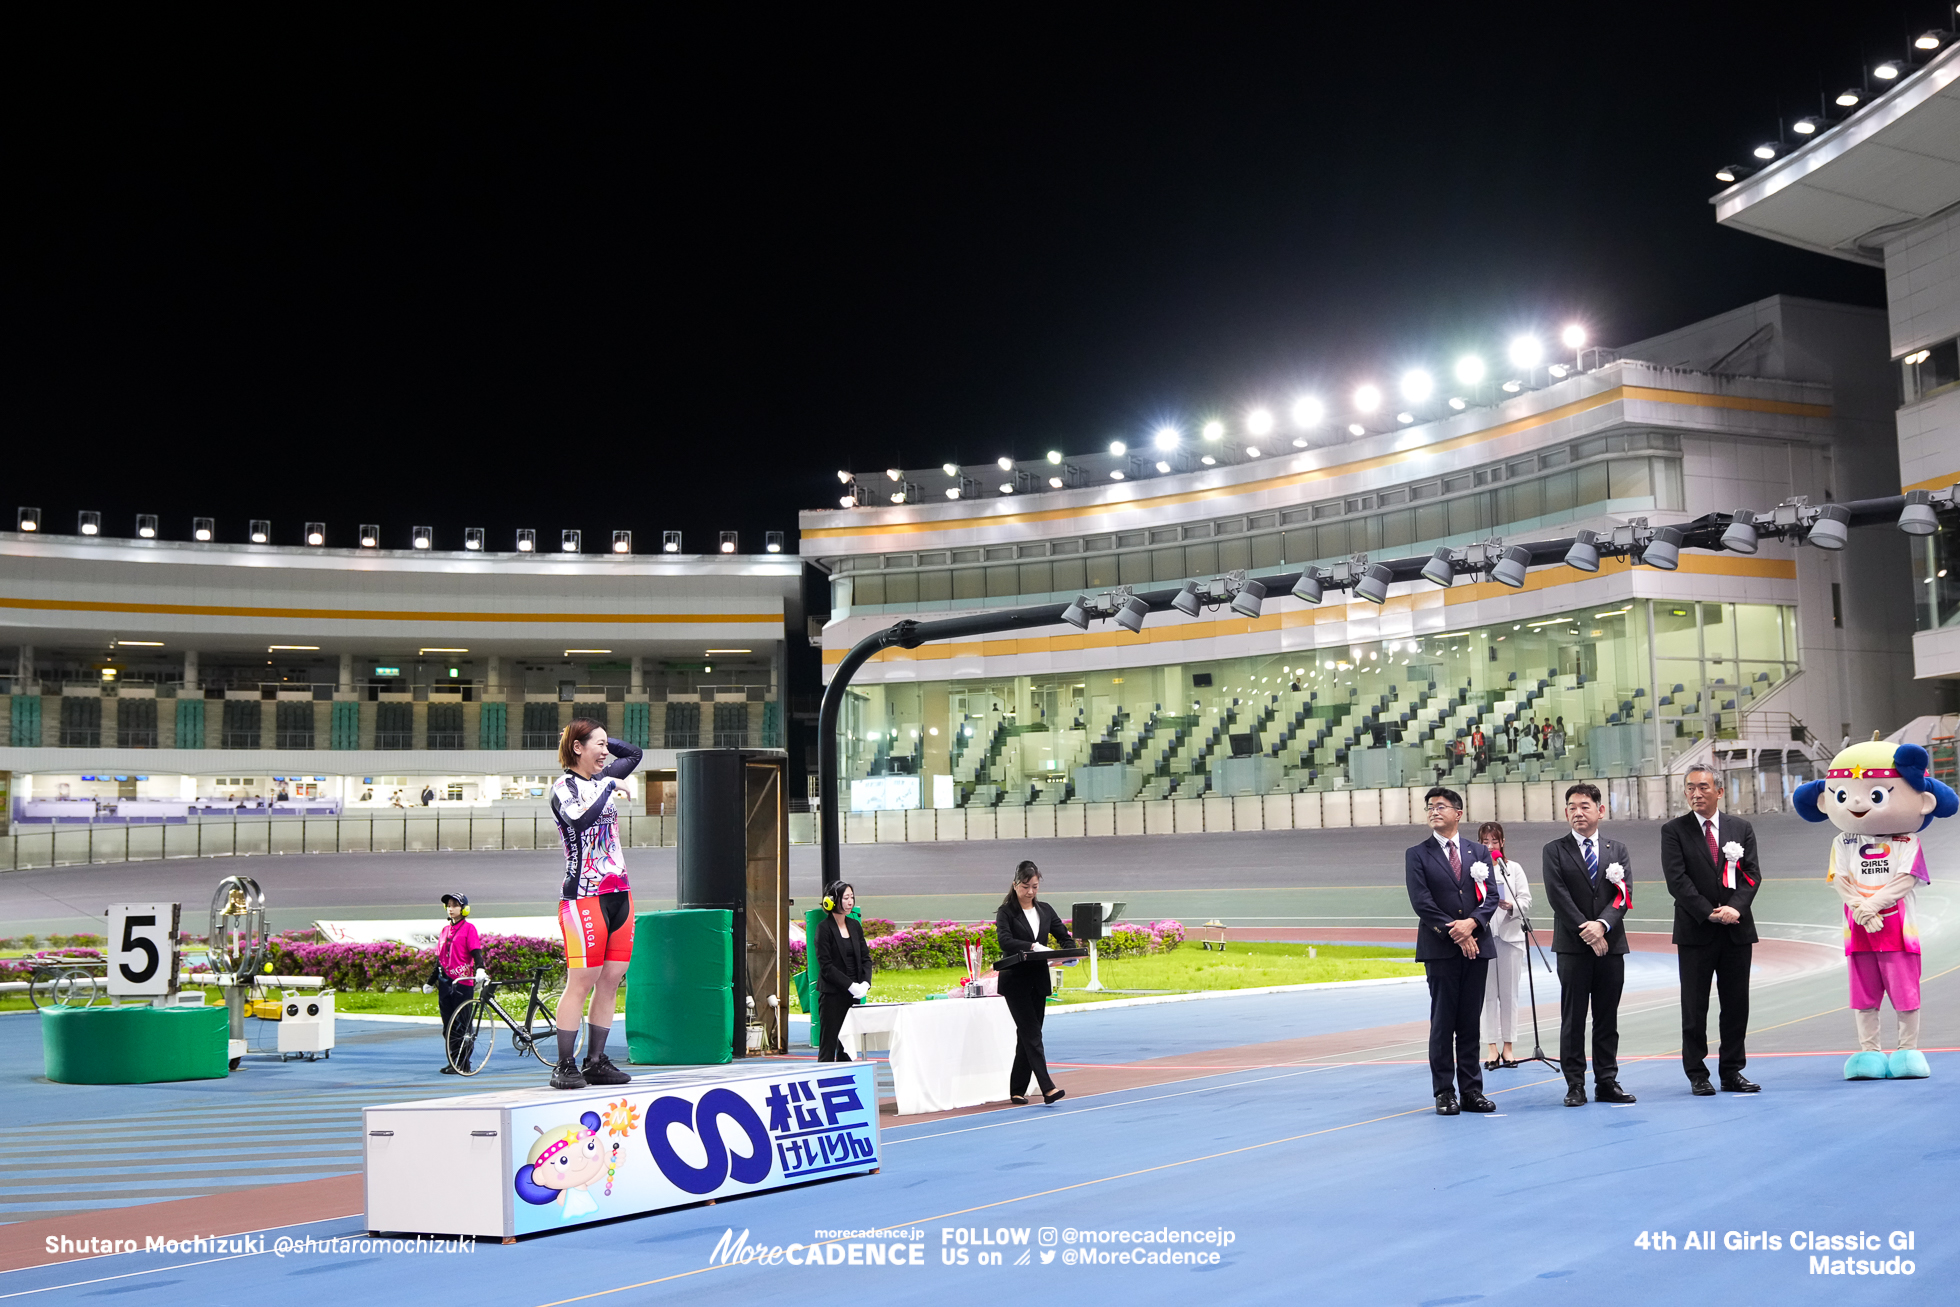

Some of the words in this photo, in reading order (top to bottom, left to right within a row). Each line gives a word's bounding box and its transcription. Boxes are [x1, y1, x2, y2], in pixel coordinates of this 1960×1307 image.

[1861, 867, 1889, 875] KEIRIN
[119, 915, 160, 984] 5
[611, 1106, 630, 1126] M
[765, 1075, 865, 1133] 松戸
[776, 1132, 874, 1172] けいりん
